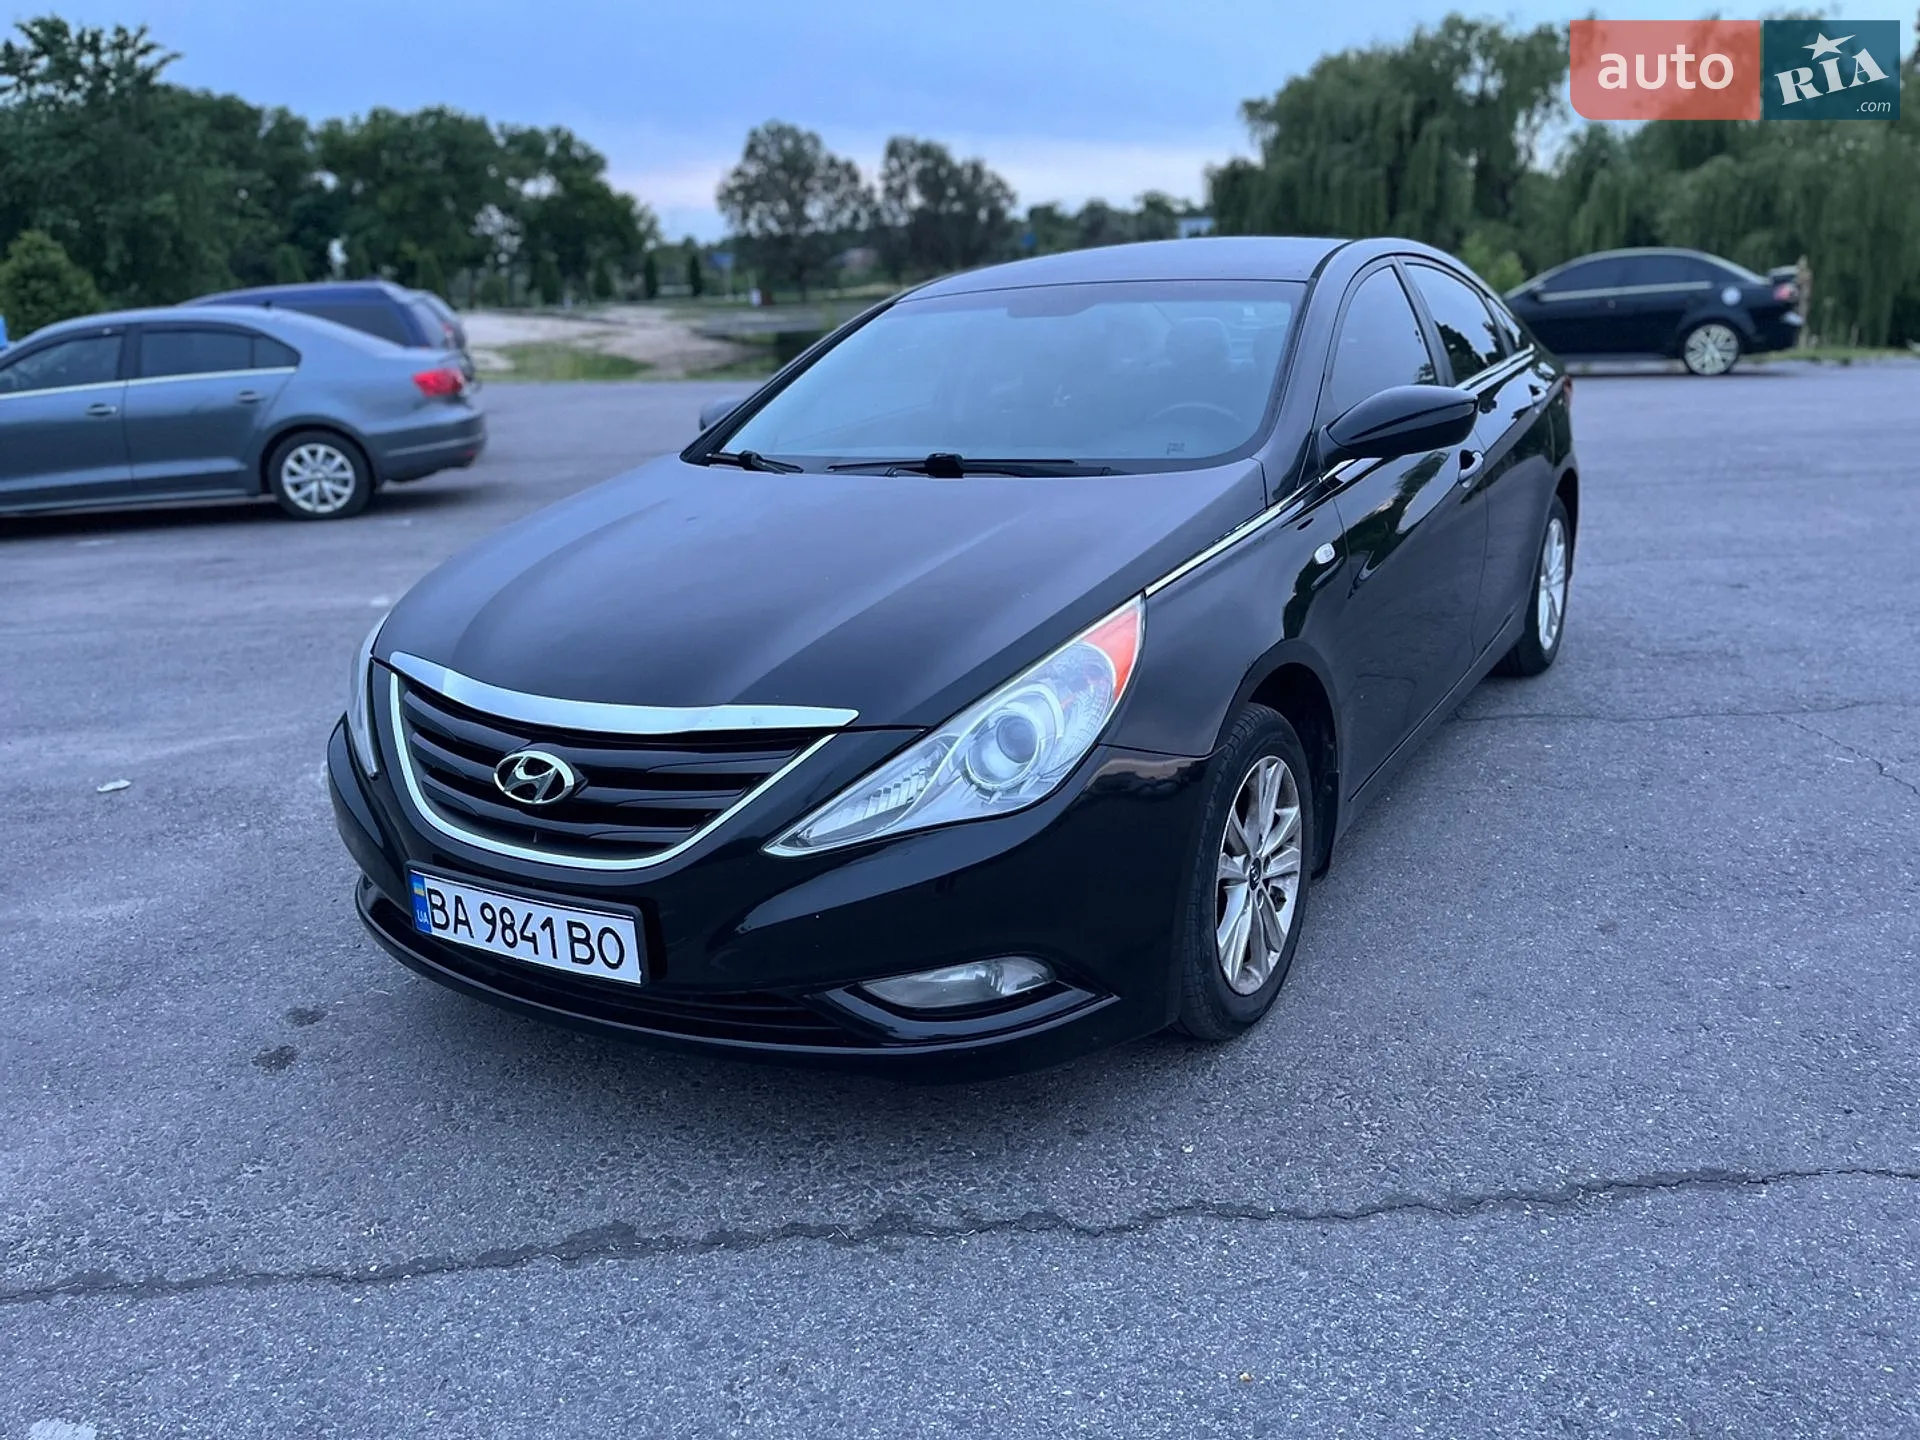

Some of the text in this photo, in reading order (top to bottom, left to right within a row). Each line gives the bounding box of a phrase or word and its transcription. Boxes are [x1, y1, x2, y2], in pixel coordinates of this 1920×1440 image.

[416, 909, 429, 925] UA
[427, 888, 625, 970] BA 9841 BO
